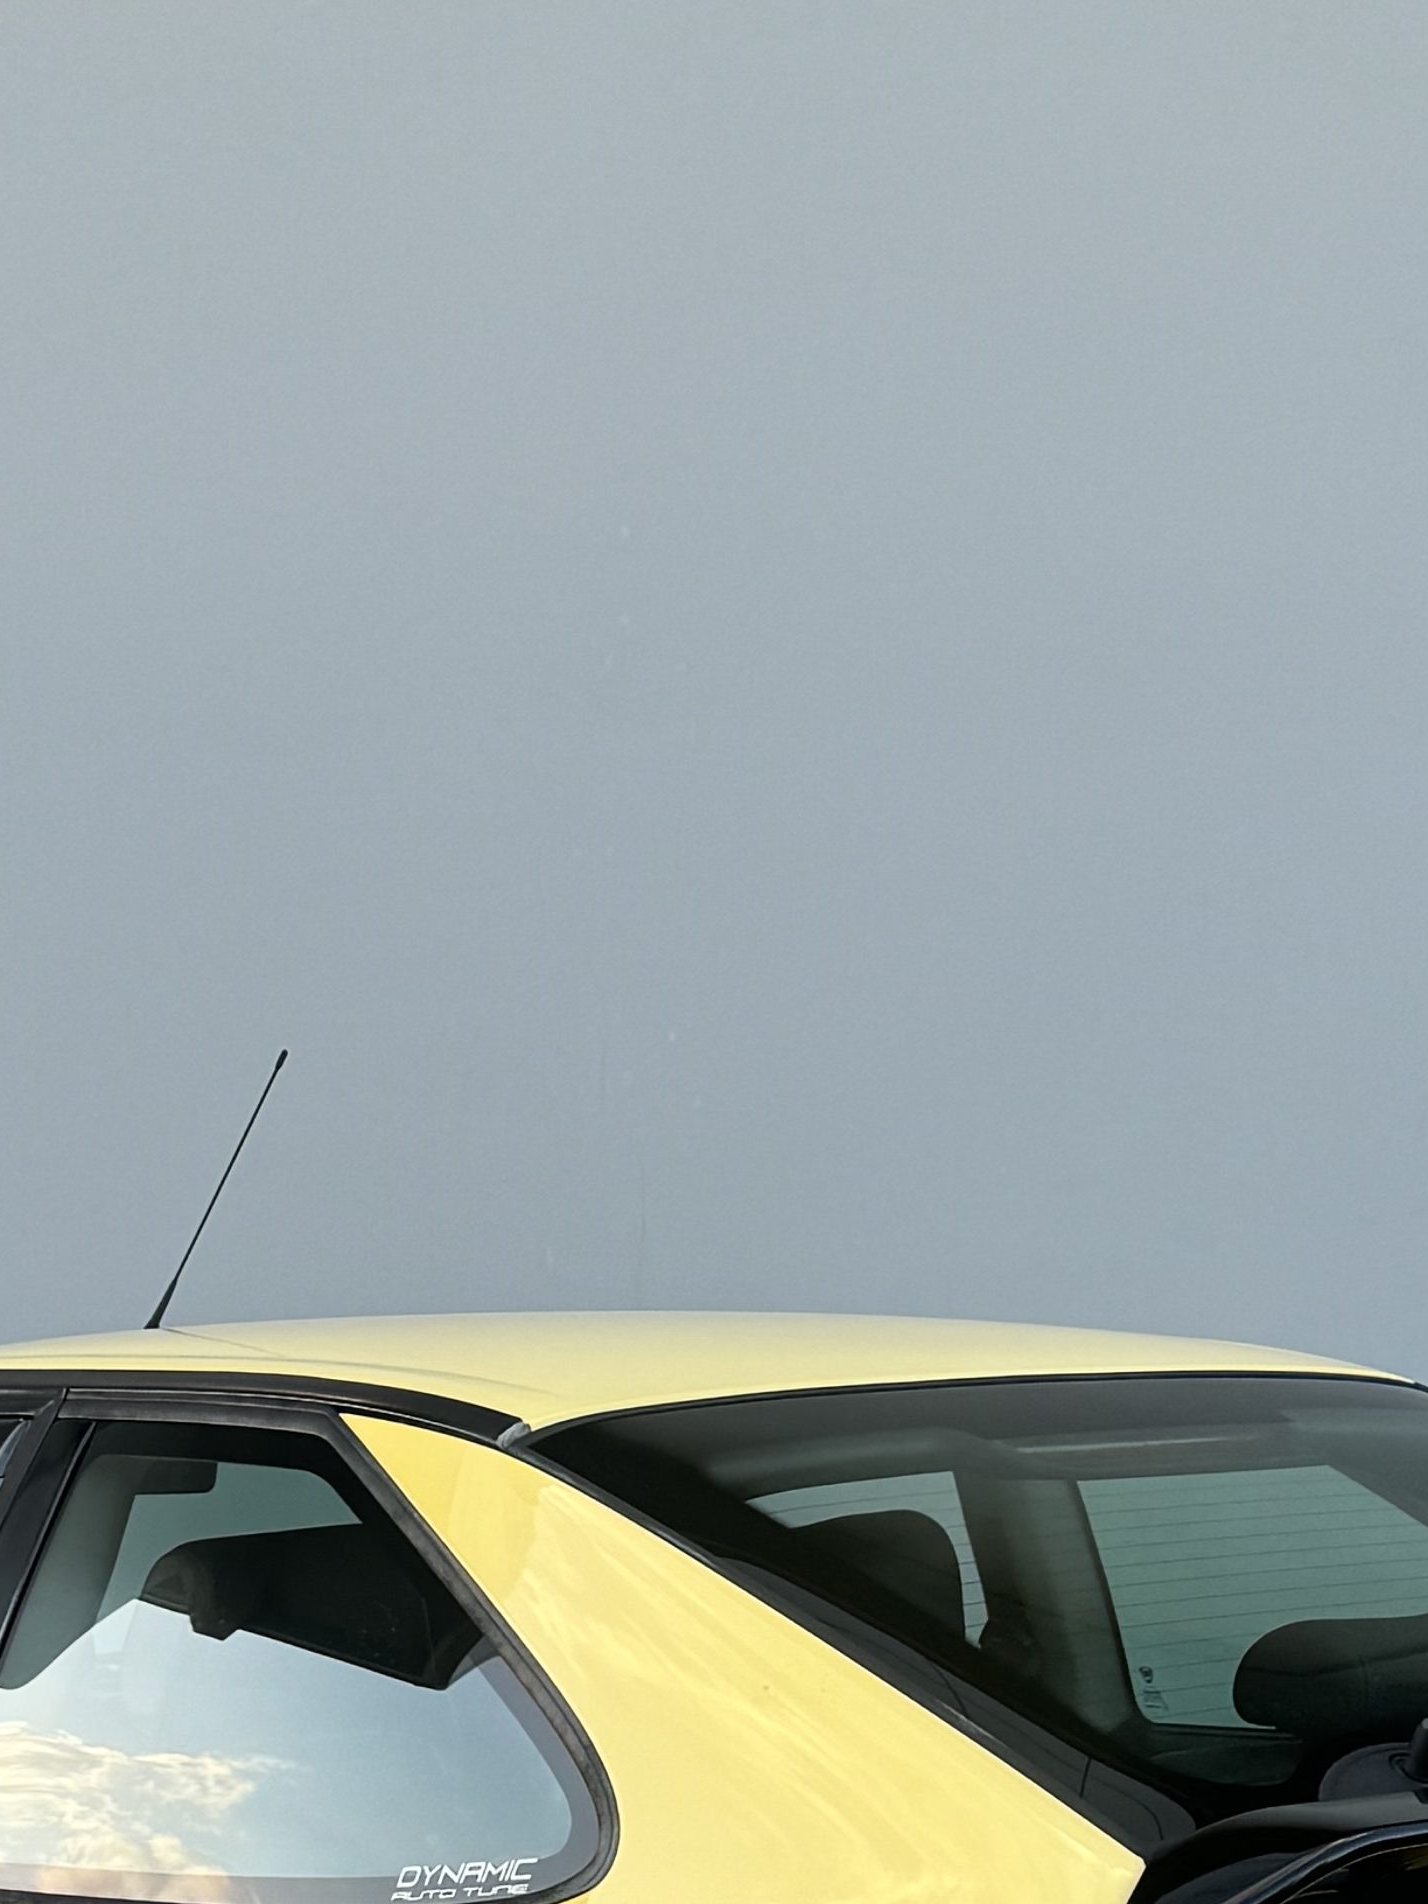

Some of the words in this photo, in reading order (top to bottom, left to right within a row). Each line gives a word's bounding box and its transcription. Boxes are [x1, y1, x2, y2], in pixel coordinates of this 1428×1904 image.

[396, 1858, 538, 1888] DYNAMIC
[390, 1888, 457, 1902] AUTO
[463, 1883, 530, 1897] TUNE
